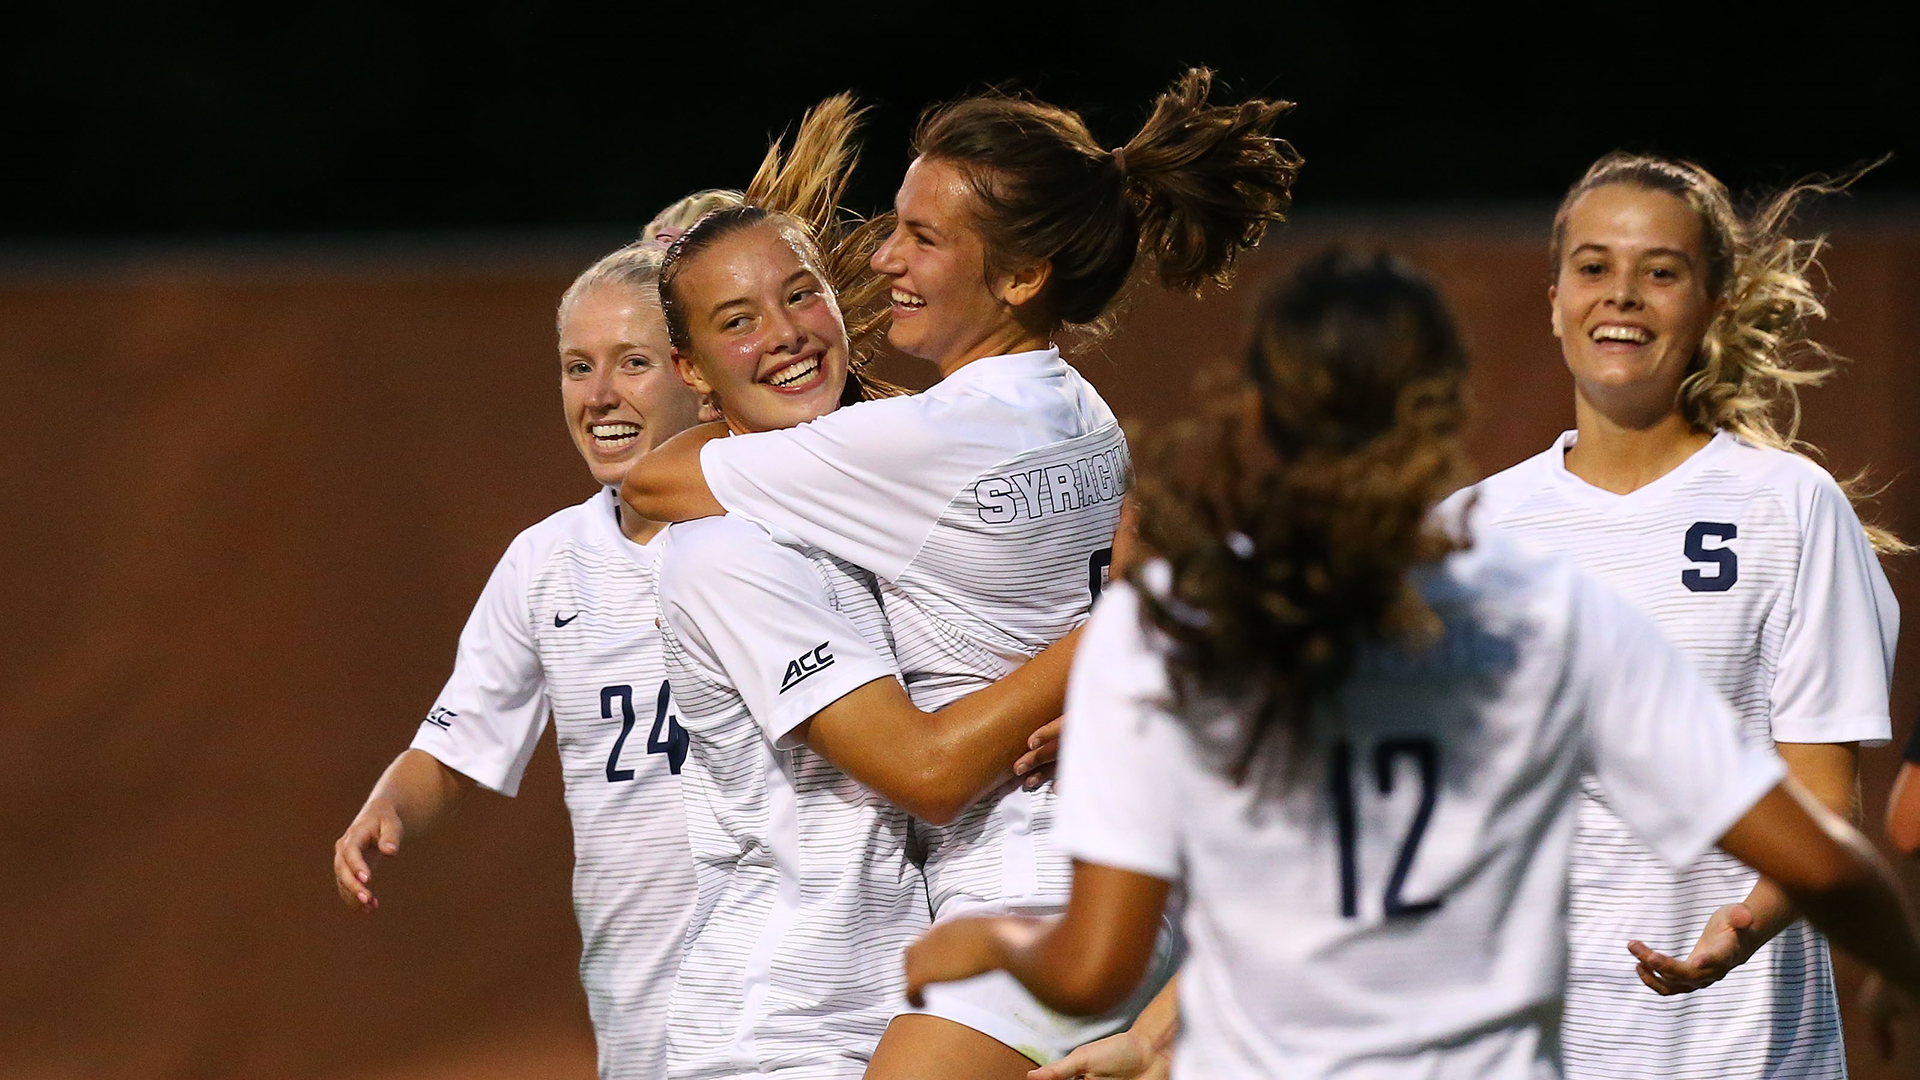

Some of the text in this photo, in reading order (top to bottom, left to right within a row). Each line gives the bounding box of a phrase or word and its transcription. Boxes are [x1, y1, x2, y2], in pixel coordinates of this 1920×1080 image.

[974, 439, 1129, 524] SYRACU
[1682, 521, 1738, 592] S
[780, 640, 835, 692] ACC
[600, 679, 690, 782] 24
[1331, 736, 1443, 919] 12
